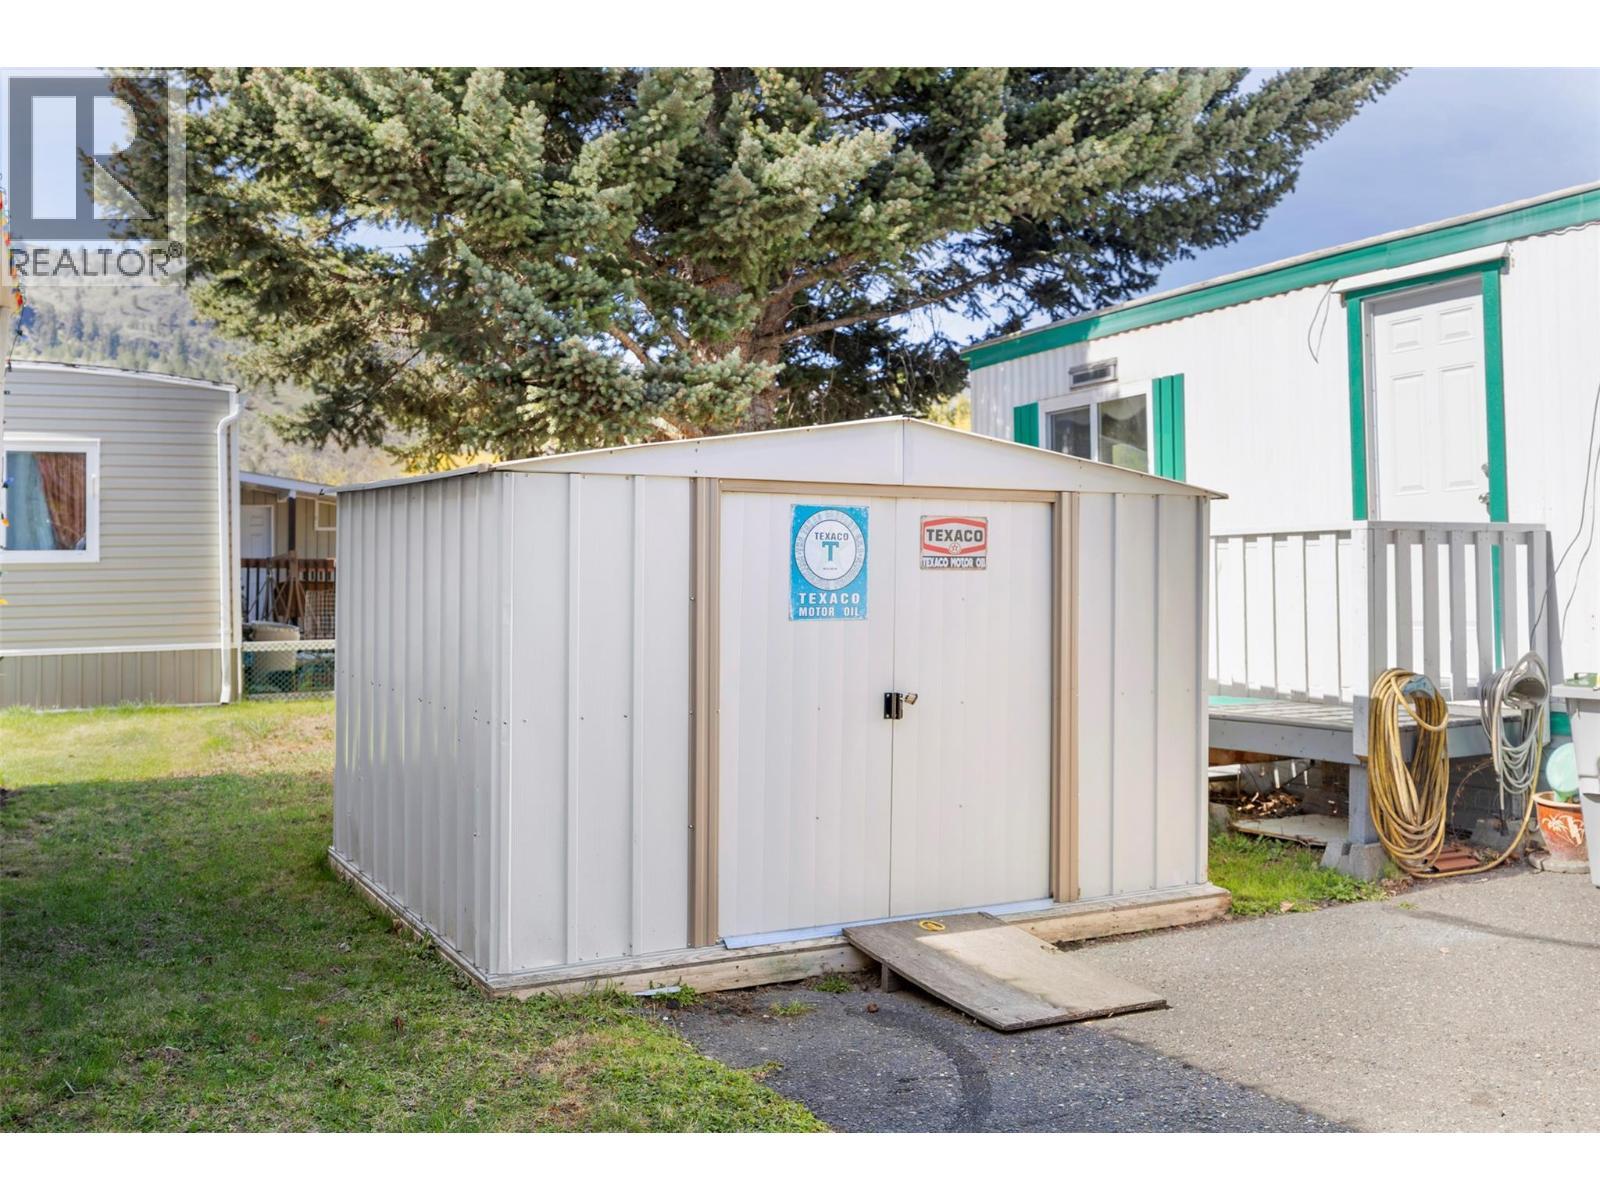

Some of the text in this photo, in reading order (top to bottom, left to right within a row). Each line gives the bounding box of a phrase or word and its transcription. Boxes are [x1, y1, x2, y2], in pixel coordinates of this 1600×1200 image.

[814, 532, 849, 541] TEXACO
[926, 529, 983, 542] TEXACO
[822, 541, 839, 562] T
[922, 557, 949, 568] TEXACO
[950, 557, 974, 568] MOTOR
[799, 593, 860, 604] TEXACO
[799, 607, 860, 617] MOTOR OIL
